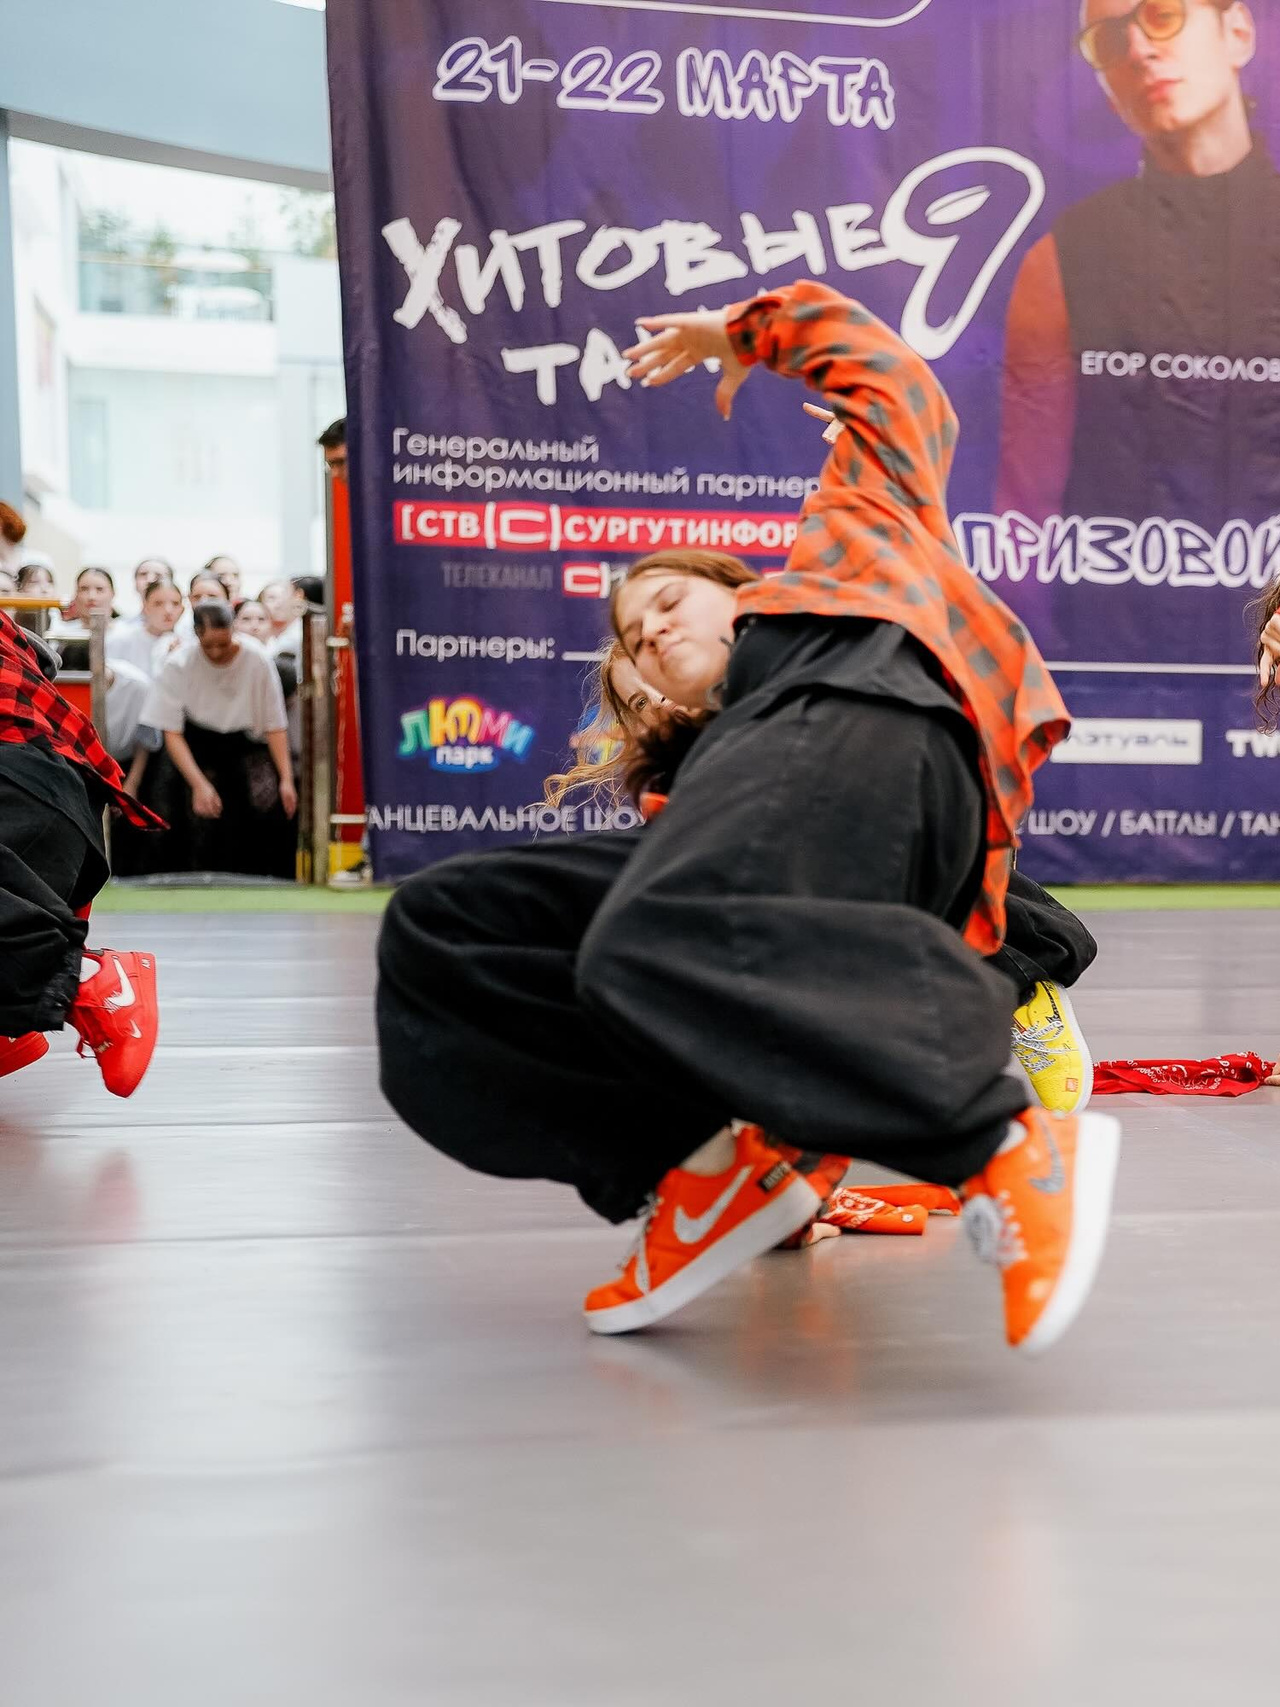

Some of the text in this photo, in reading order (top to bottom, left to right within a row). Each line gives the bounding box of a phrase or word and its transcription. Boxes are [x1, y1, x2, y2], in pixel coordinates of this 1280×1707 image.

[432, 35, 896, 130] 21-22 МАРТА
[1081, 350, 1147, 377] ЕГОР
[393, 427, 600, 464] Генеральный
[393, 458, 690, 494] информационный
[396, 629, 556, 664] Партнеры:
[436, 745, 494, 769] парк
[365, 803, 578, 833] АНЦЕВАЛЬНОЕ
[1028, 808, 1098, 836] ШОУ
[1120, 809, 1217, 837] БАТТЛЫ
